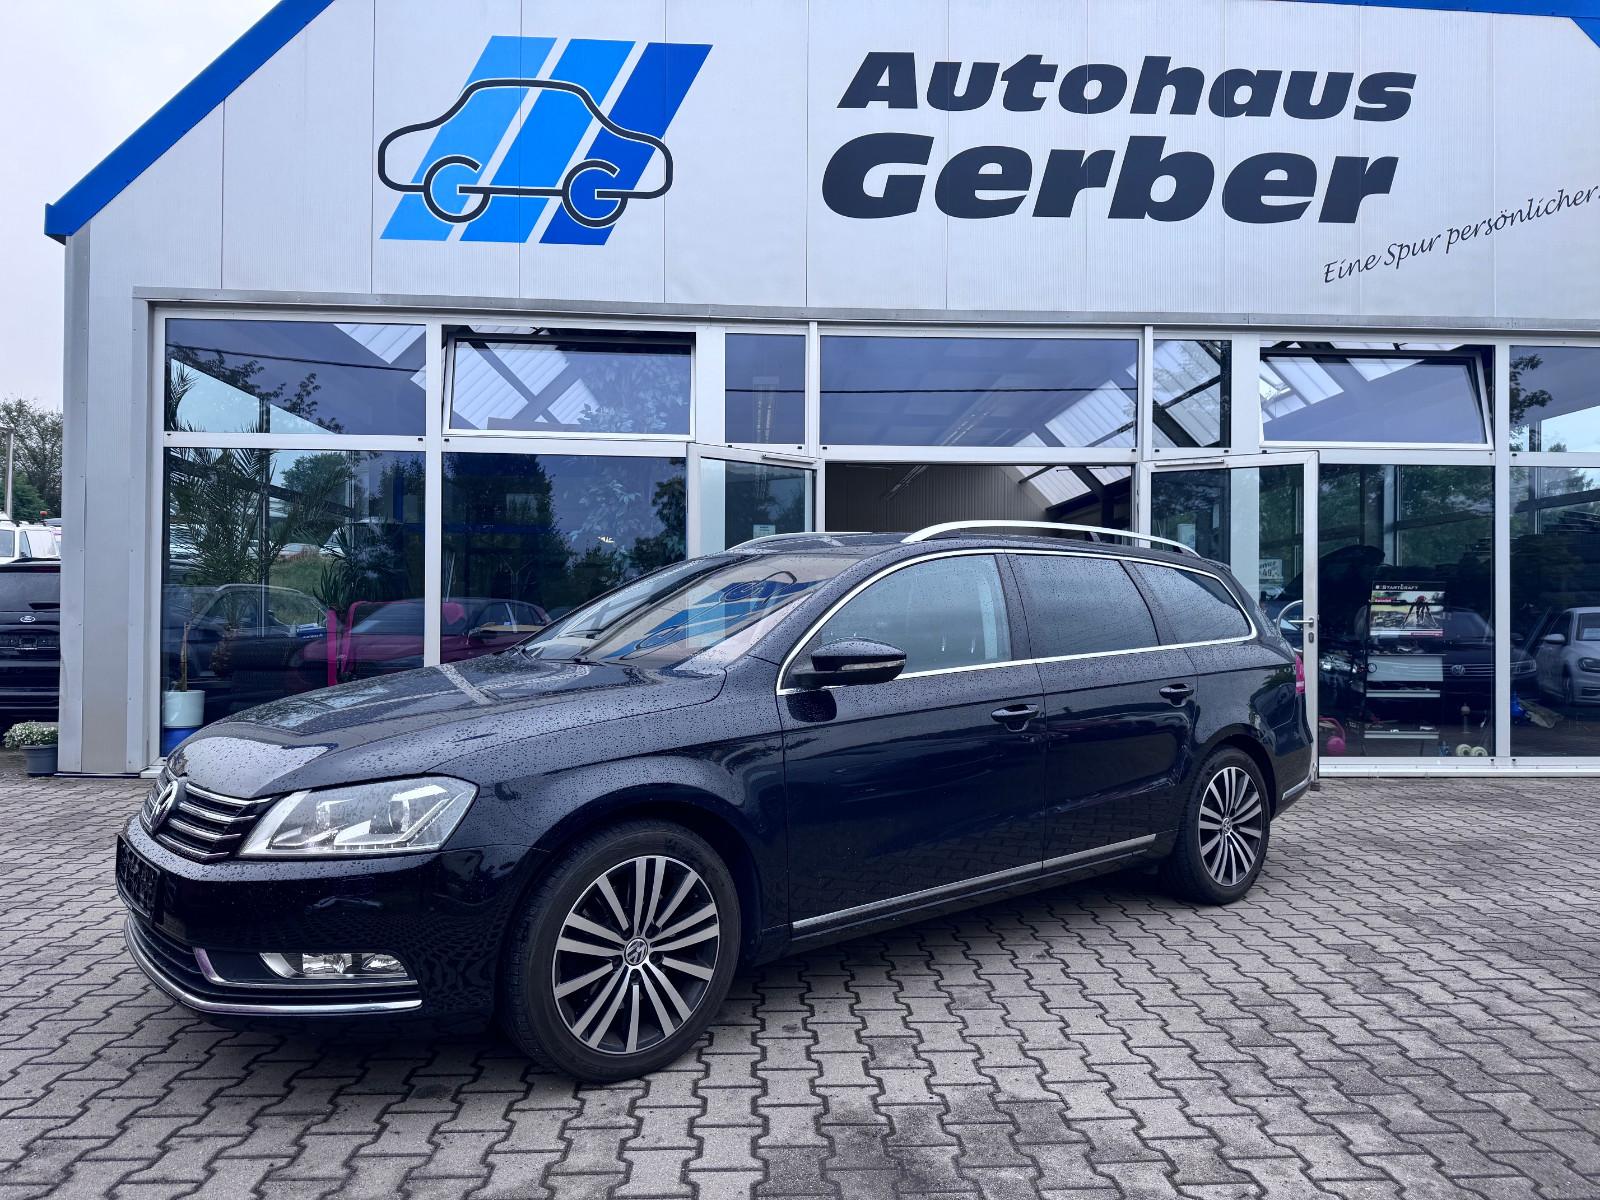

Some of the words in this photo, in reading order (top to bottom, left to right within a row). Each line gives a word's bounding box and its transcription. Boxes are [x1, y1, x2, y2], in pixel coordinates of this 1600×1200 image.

[837, 52, 1417, 122] Autohaus
[822, 133, 1399, 224] Gerber
[1324, 254, 1383, 284] Eine
[1384, 234, 1442, 270] Spur
